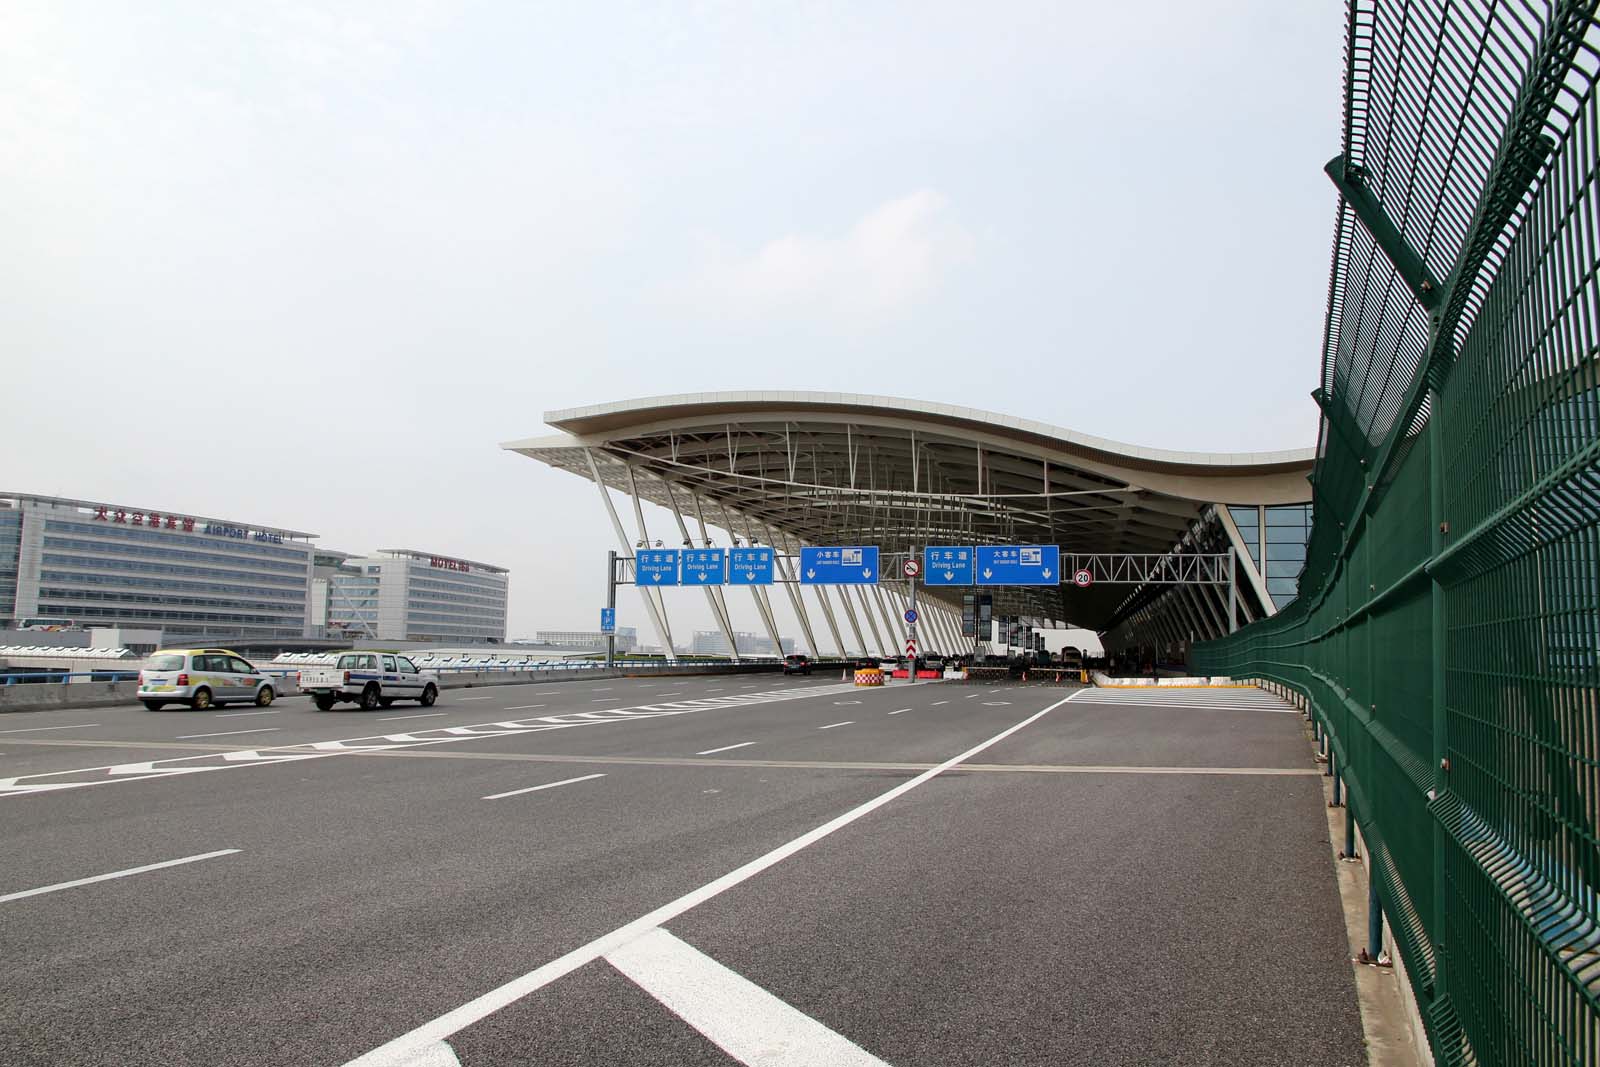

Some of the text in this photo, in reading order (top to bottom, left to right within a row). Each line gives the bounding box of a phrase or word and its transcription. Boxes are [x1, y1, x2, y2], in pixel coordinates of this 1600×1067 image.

[94, 506, 196, 533] 大众空港宾馆
[204, 525, 283, 545] AIRPORT HOTEL
[641, 554, 674, 563] 行车道
[686, 553, 720, 562] 行车道
[734, 553, 769, 562] 行车道
[931, 551, 968, 560] 行车道
[431, 556, 458, 571] MOTEL
[687, 563, 705, 571] Driving
[734, 563, 753, 571] Driving
[931, 562, 951, 570] Driving
[641, 565, 659, 573] Driving
[1078, 574, 1089, 583] 20
